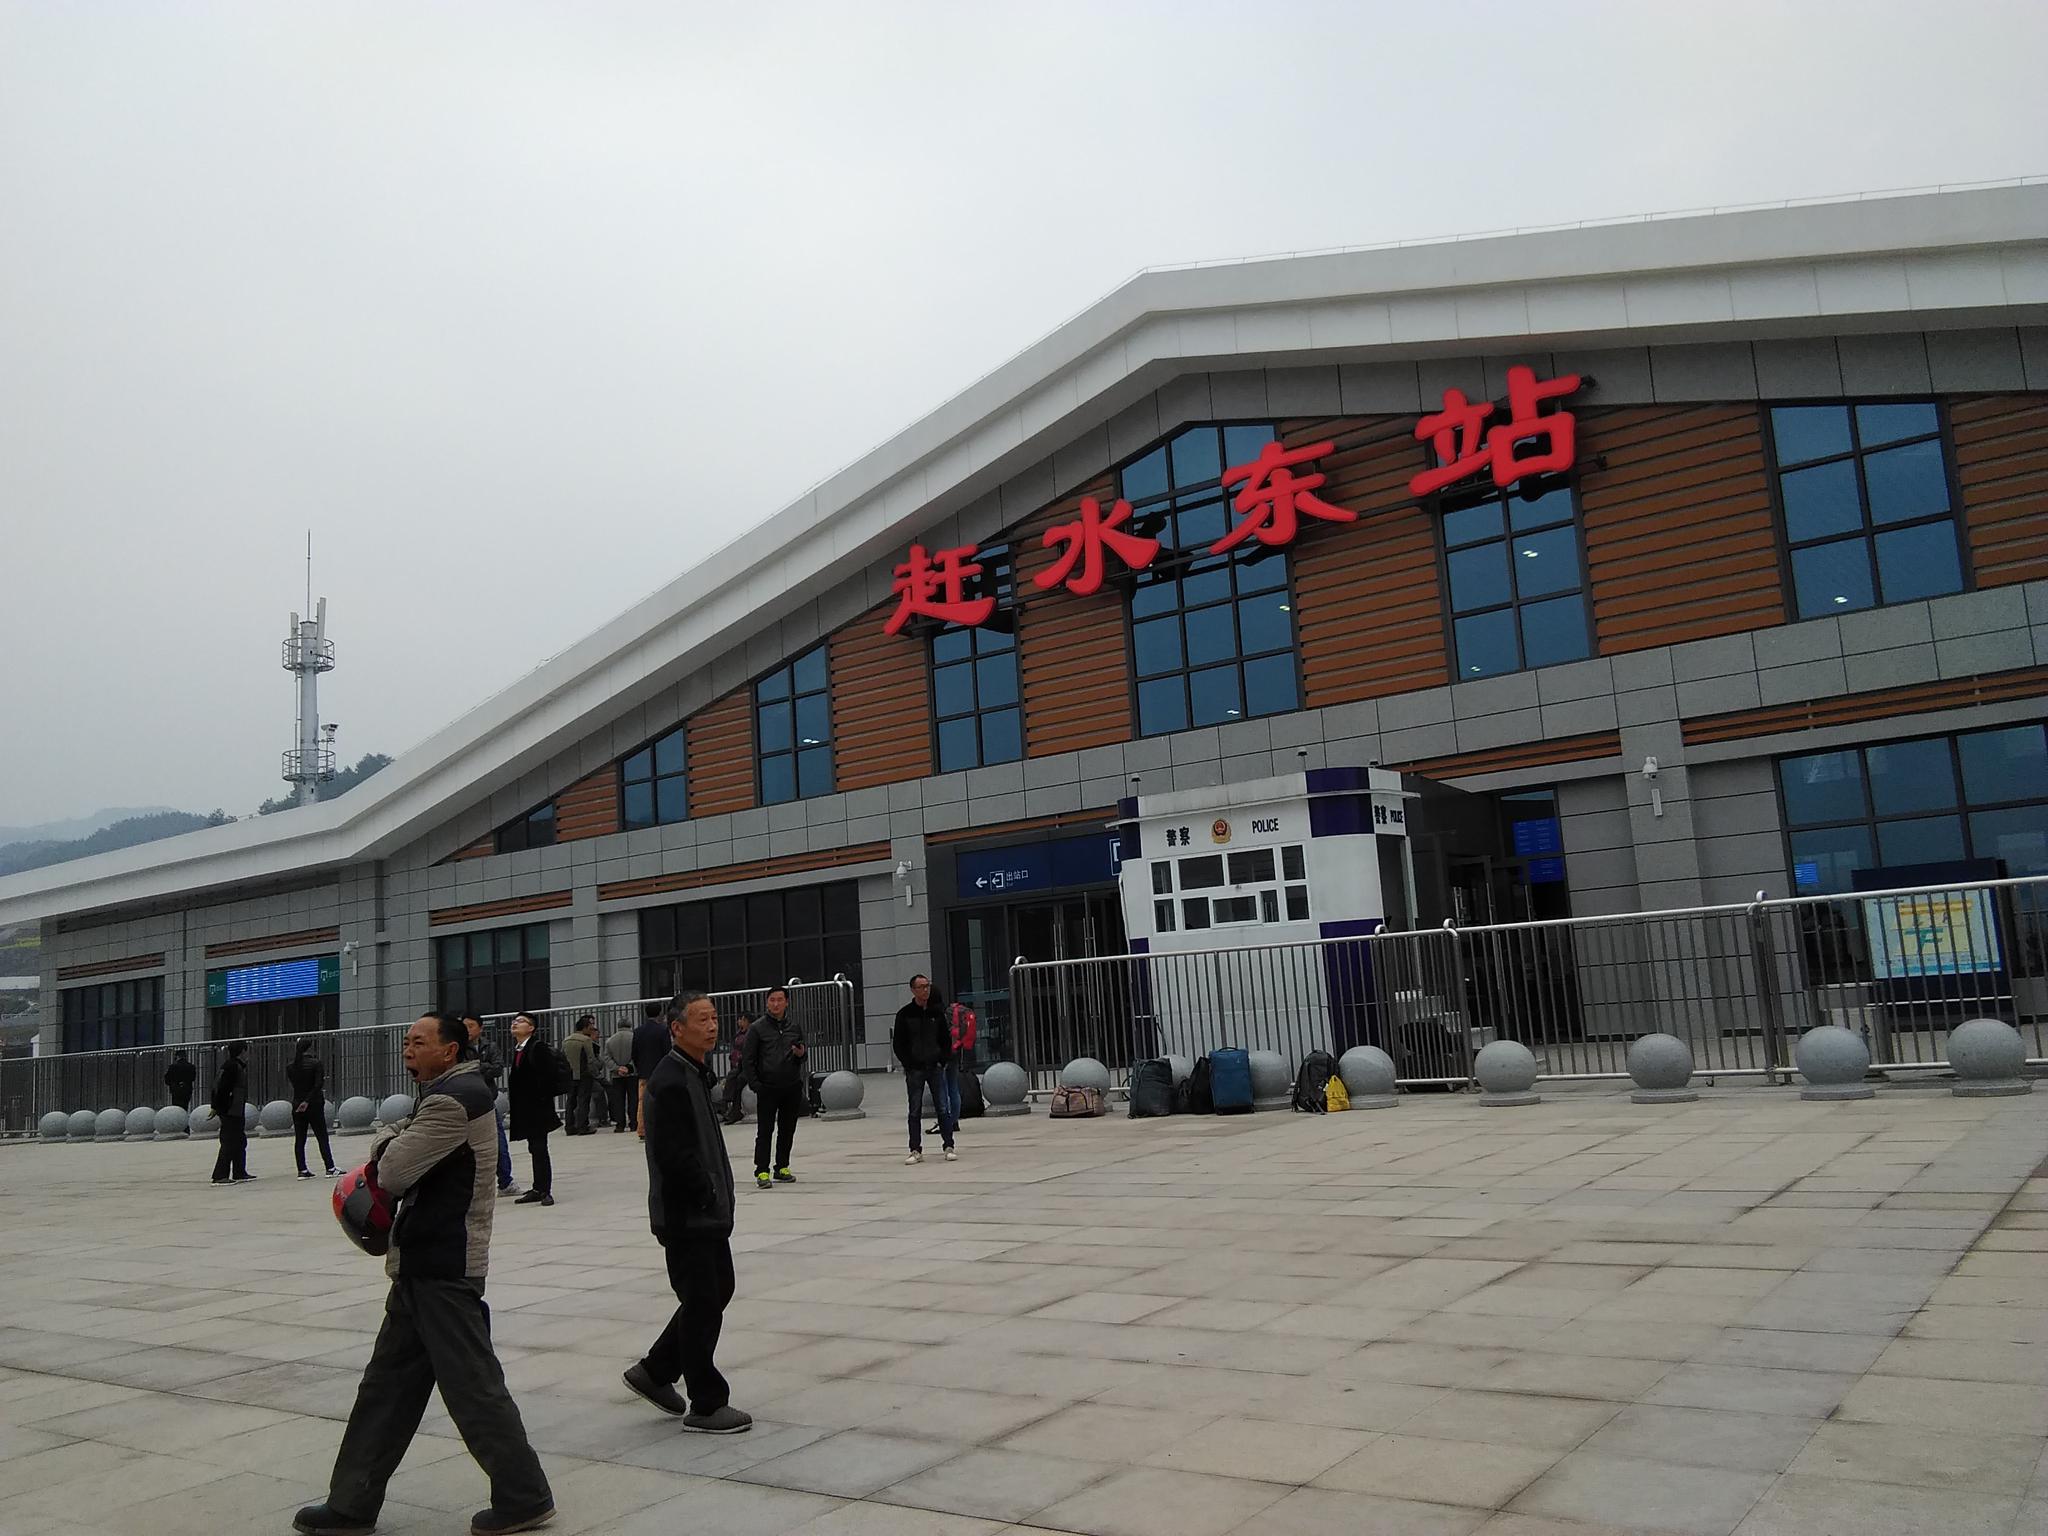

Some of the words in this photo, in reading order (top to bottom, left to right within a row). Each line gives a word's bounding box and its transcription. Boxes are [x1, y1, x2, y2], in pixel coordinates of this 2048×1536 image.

[885, 368, 1578, 635] 赶水东站
[1252, 818, 1279, 834] POLICE
[1165, 826, 1190, 847] 警察
[1006, 870, 1028, 881] 出站口
